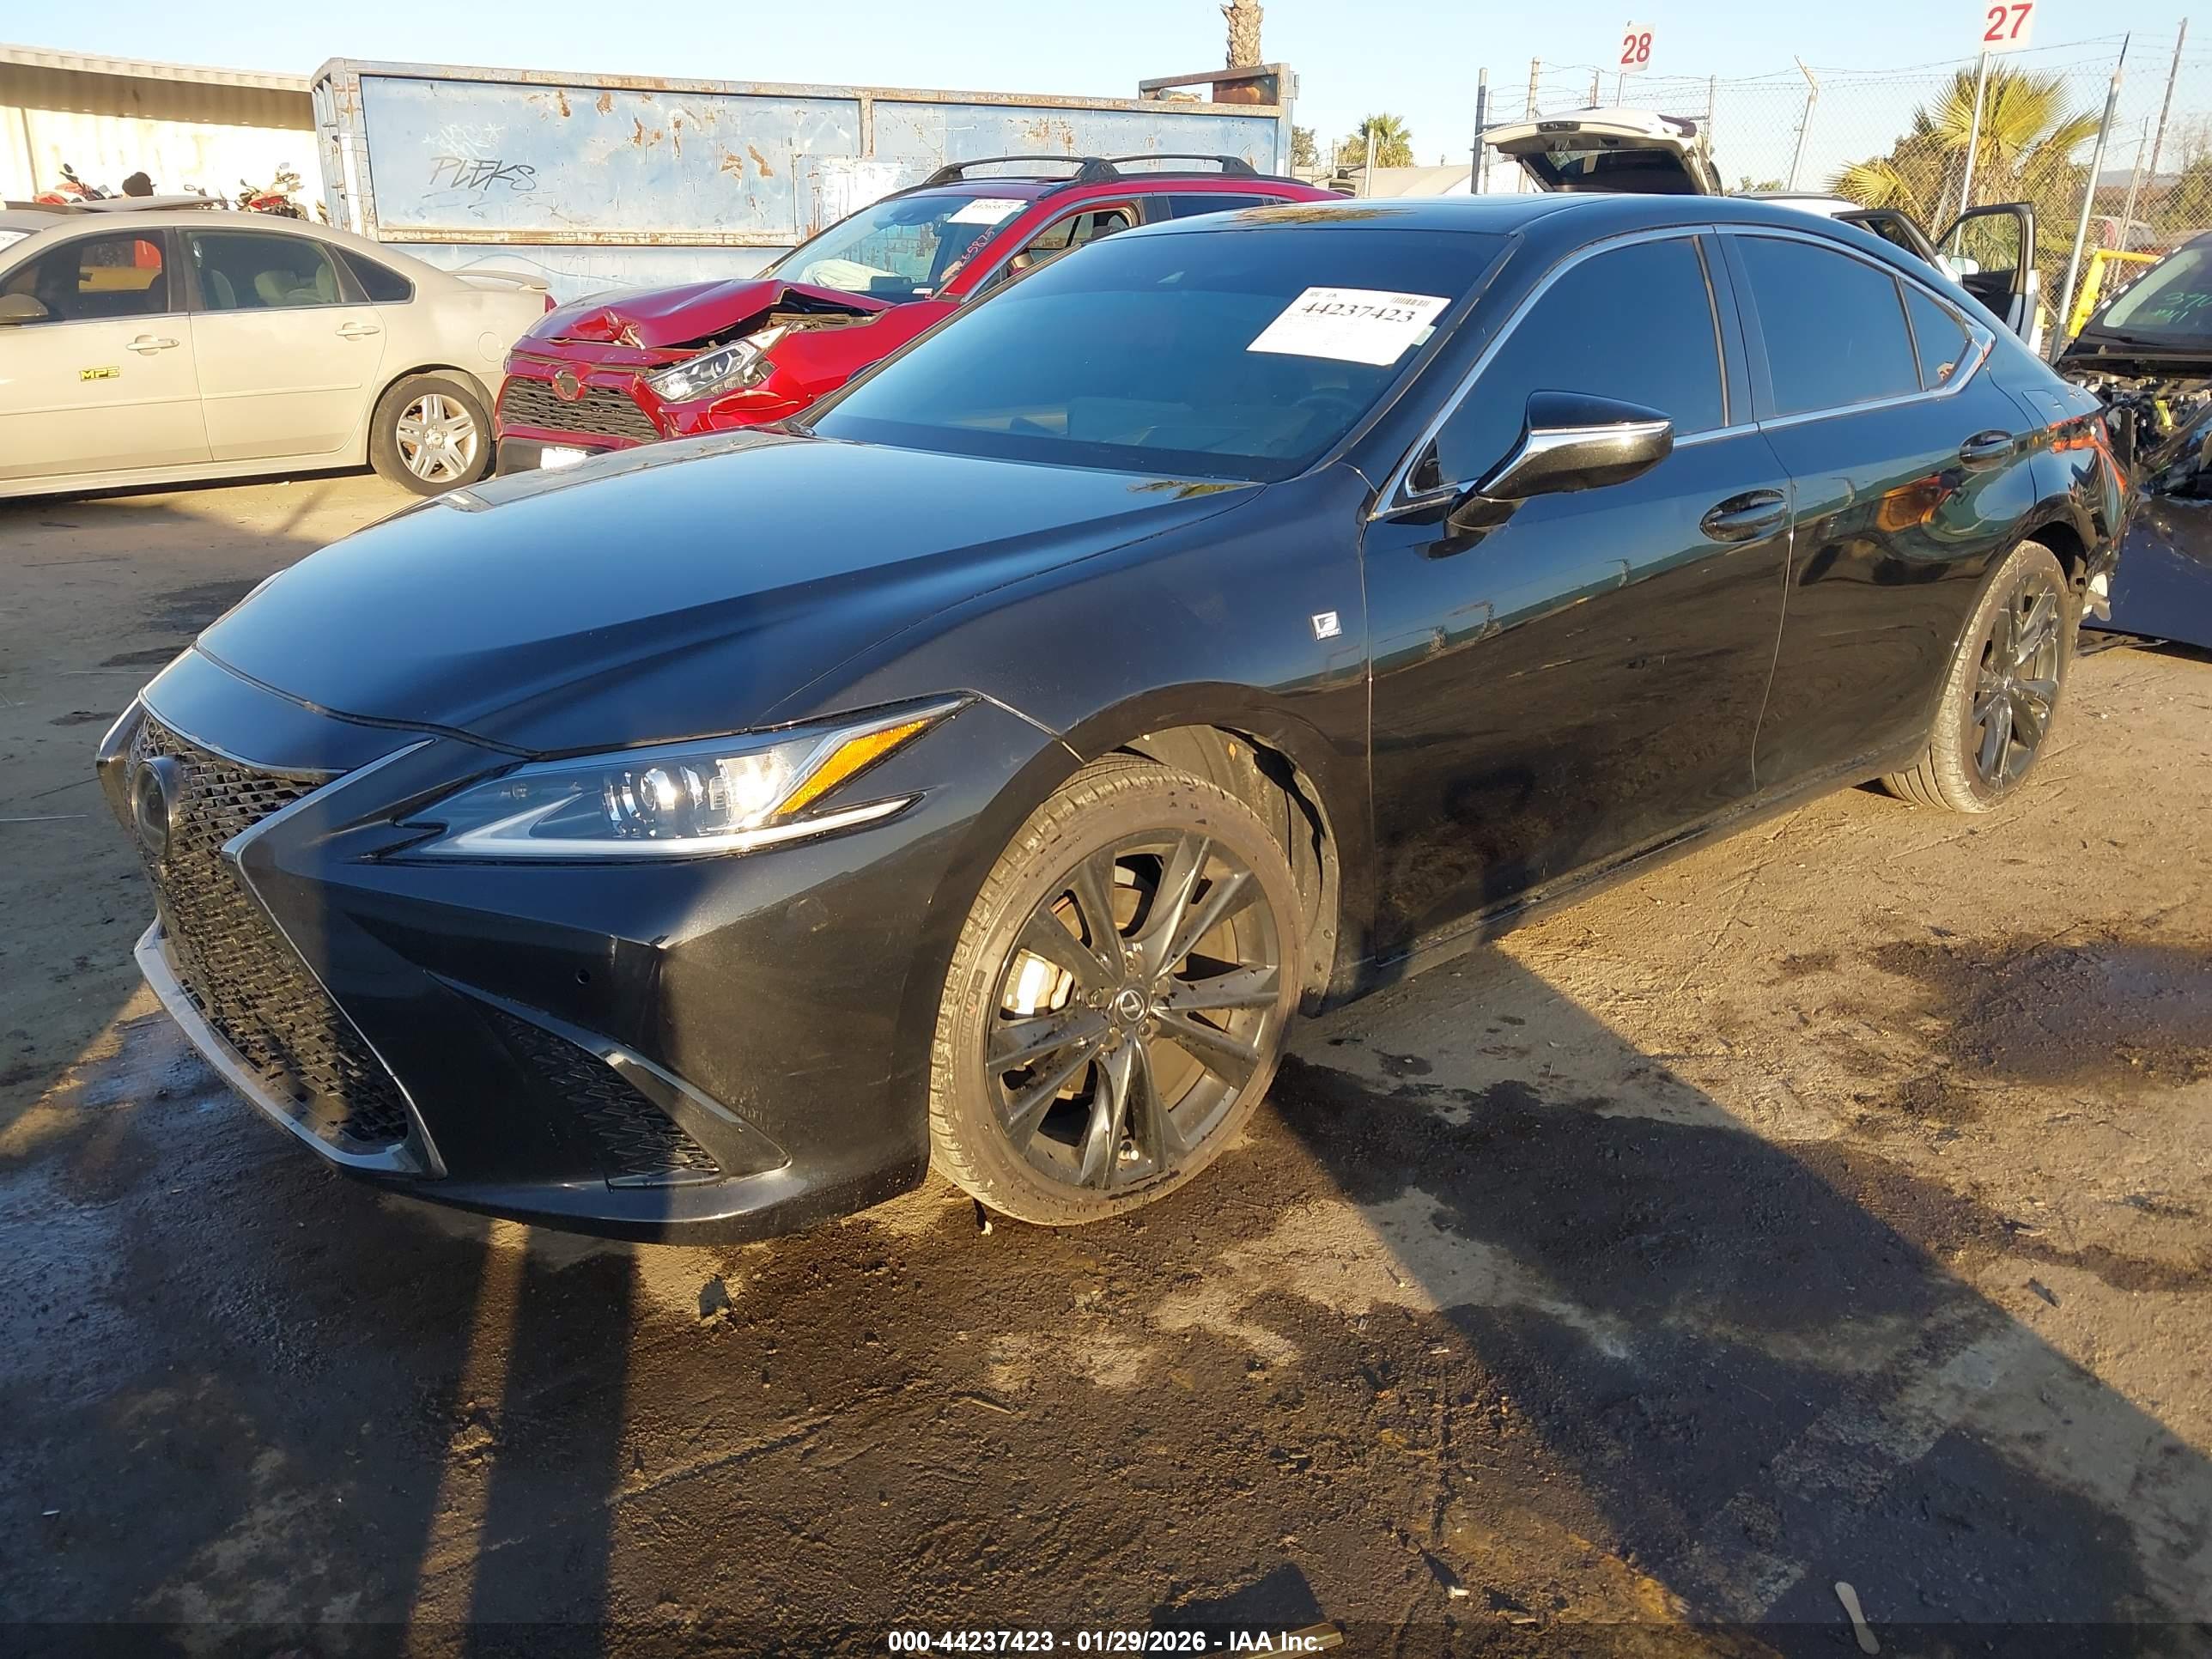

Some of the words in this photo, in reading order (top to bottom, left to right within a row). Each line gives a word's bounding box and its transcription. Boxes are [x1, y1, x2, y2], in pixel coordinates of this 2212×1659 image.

[1984, 3, 2033, 41] 27
[1620, 32, 1652, 64] 28
[1300, 301, 1417, 324] 44237423
